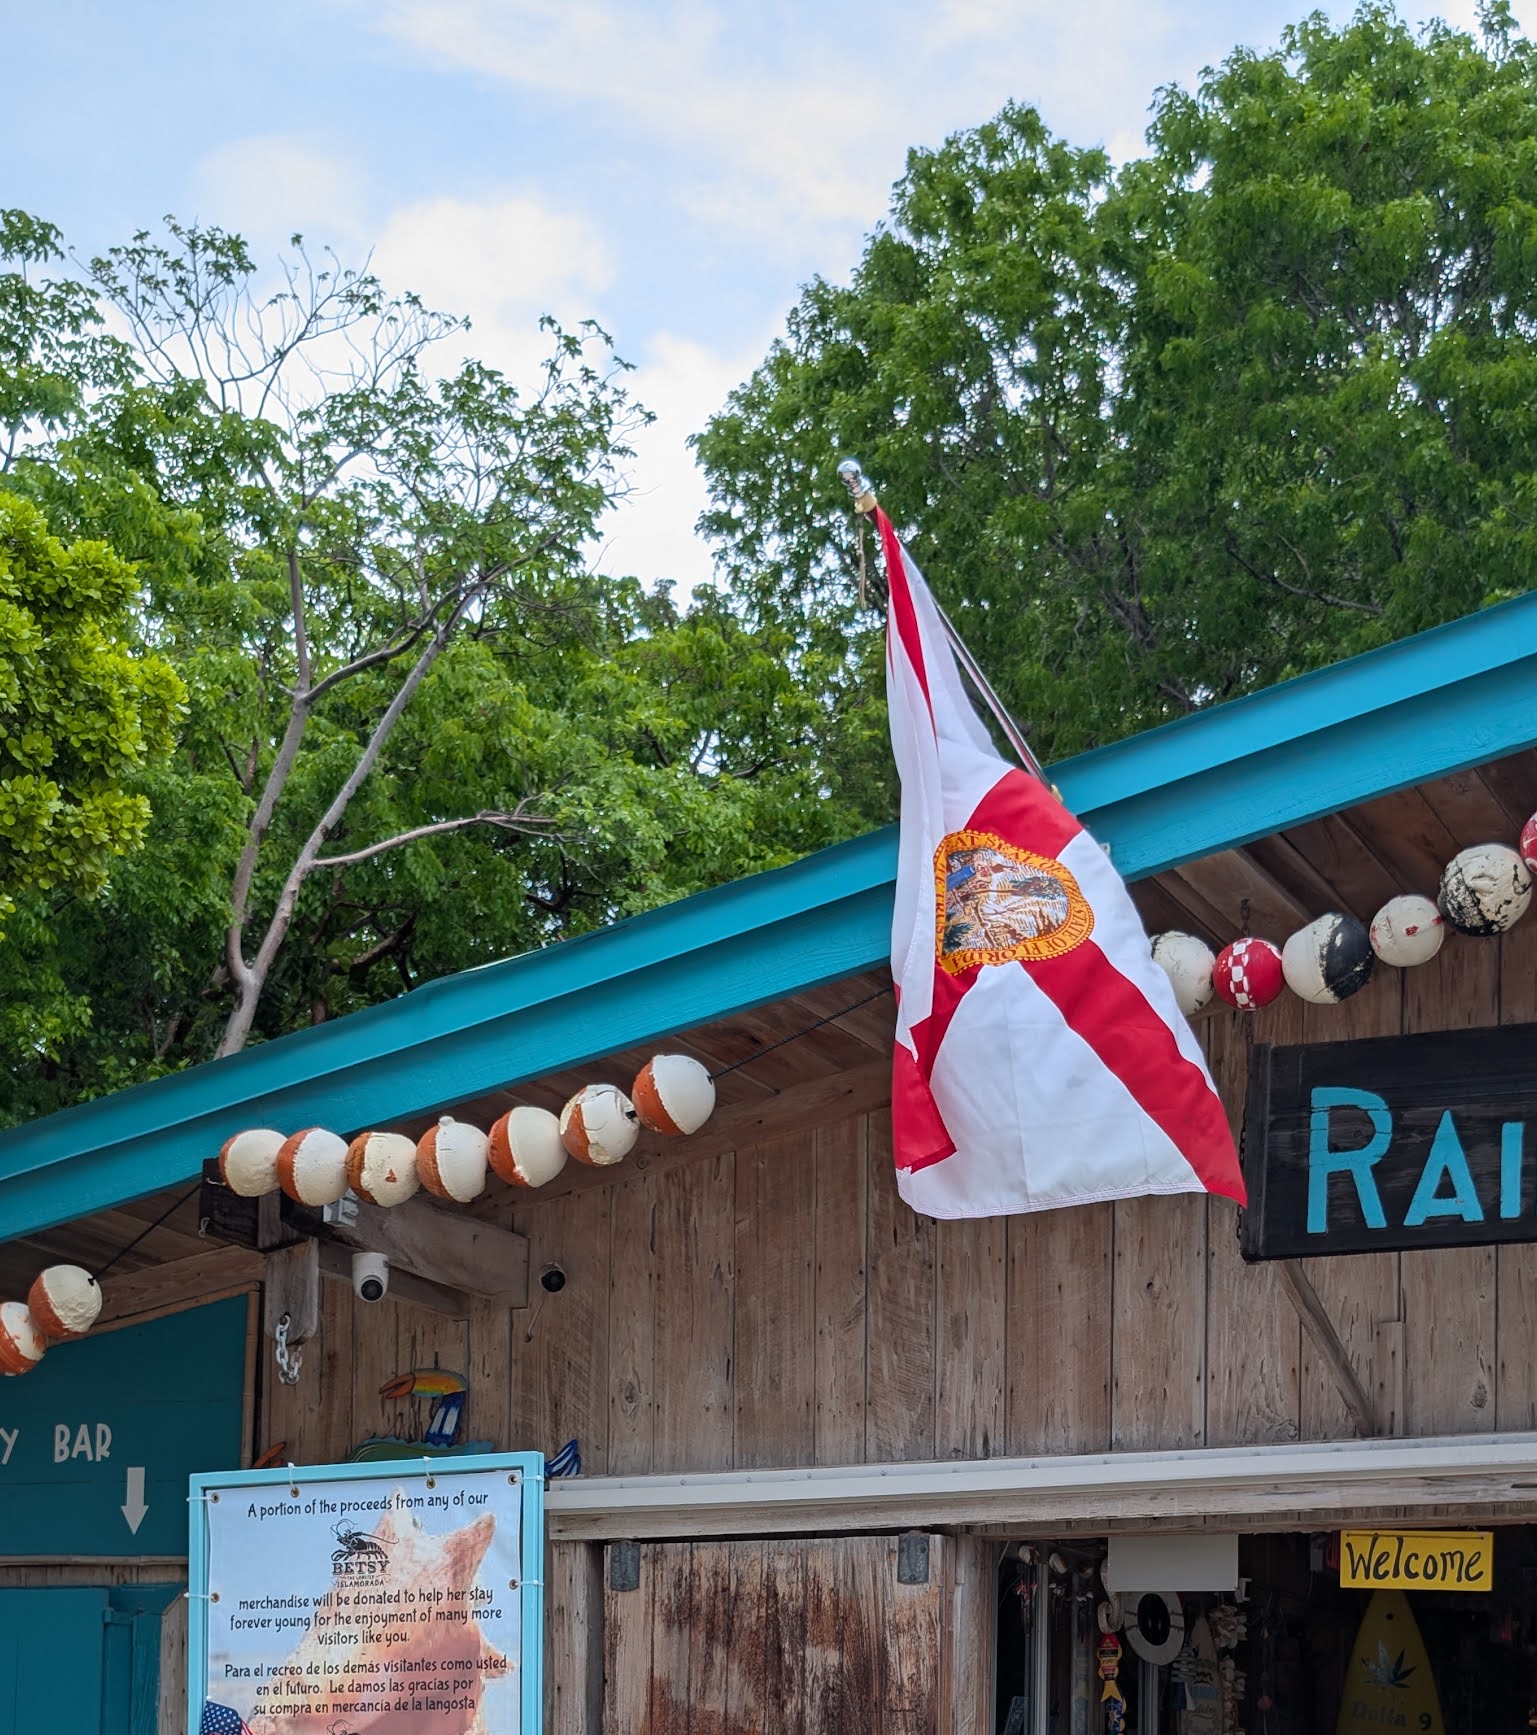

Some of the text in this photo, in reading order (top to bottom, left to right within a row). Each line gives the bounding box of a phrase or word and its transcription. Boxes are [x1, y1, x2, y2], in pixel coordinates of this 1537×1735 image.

[54, 1424, 112, 1463] BAR
[248, 1492, 488, 1520] A portion of the proceeds from any of our
[332, 1559, 390, 1575] BETSY
[1346, 1534, 1484, 1582] Welcome
[337, 1580, 384, 1588] ISLAMORADA
[239, 1587, 493, 1610] merchandise will be donated to help her stay
[230, 1608, 502, 1631] forever young for the enjoyment of many more
[318, 1630, 410, 1647] visitors like you.
[225, 1656, 507, 1678] Para el recreo de los demás visitantes como usted
[256, 1678, 473, 1696] en el futuro. Le damos las gracias por
[254, 1696, 475, 1718] su compra en mercancía de la langosta
